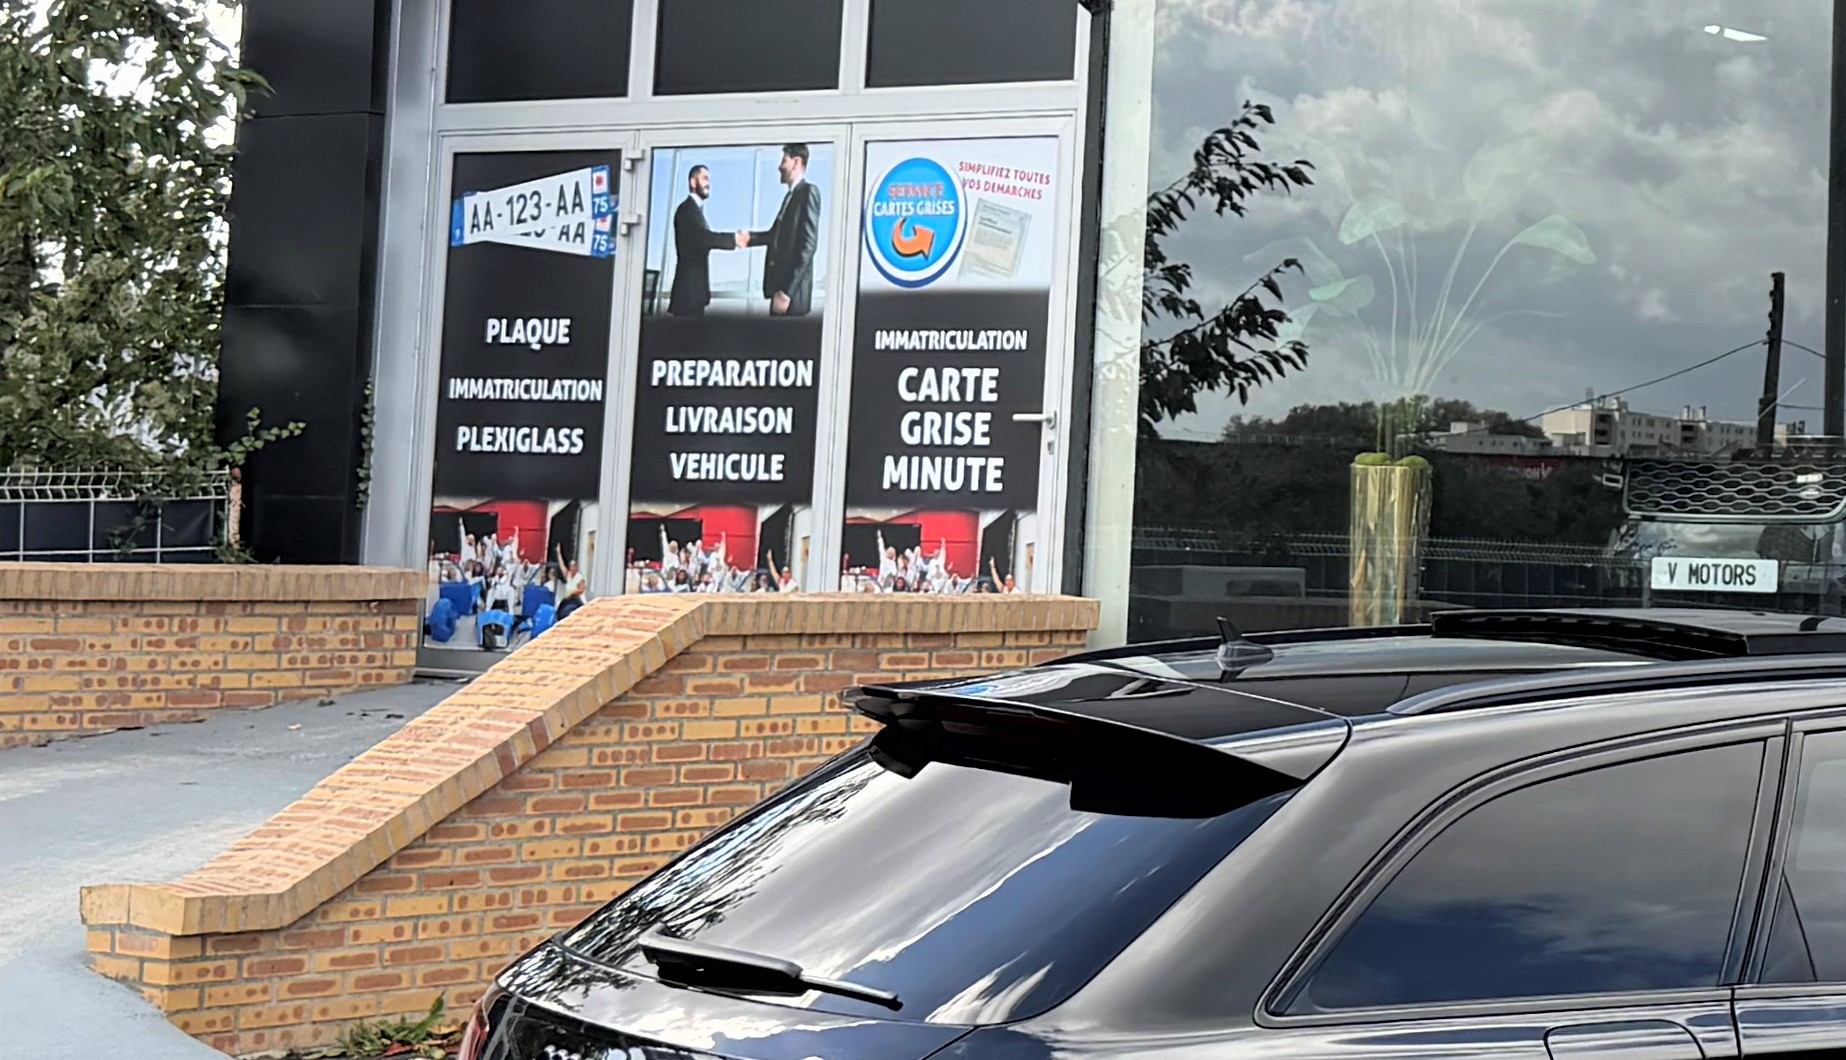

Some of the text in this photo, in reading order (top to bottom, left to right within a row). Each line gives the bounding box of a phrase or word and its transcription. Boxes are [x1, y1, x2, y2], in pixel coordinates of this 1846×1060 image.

[959, 161, 1050, 185] SIMPLIFIEZ TOUTES
[963, 177, 1042, 200] VOS DEMARCHES
[593, 196, 608, 213] 75
[873, 200, 955, 217] CARTES GRISES
[593, 235, 608, 251] 75
[486, 318, 571, 350] PLAQUE
[875, 330, 1028, 351] IMMATRICULATION
[651, 359, 813, 387] PREPARATION
[898, 367, 1000, 402] CARTE
[448, 378, 603, 401] IMMATRICULATION
[665, 406, 793, 434] LIVRAISON
[901, 411, 992, 446] GRISE
[456, 426, 584, 454] PLEXIGLASS
[670, 452, 785, 481] VEHICULE
[882, 455, 1004, 492] MINUTE
[1668, 562, 1756, 586] V MOTORS
